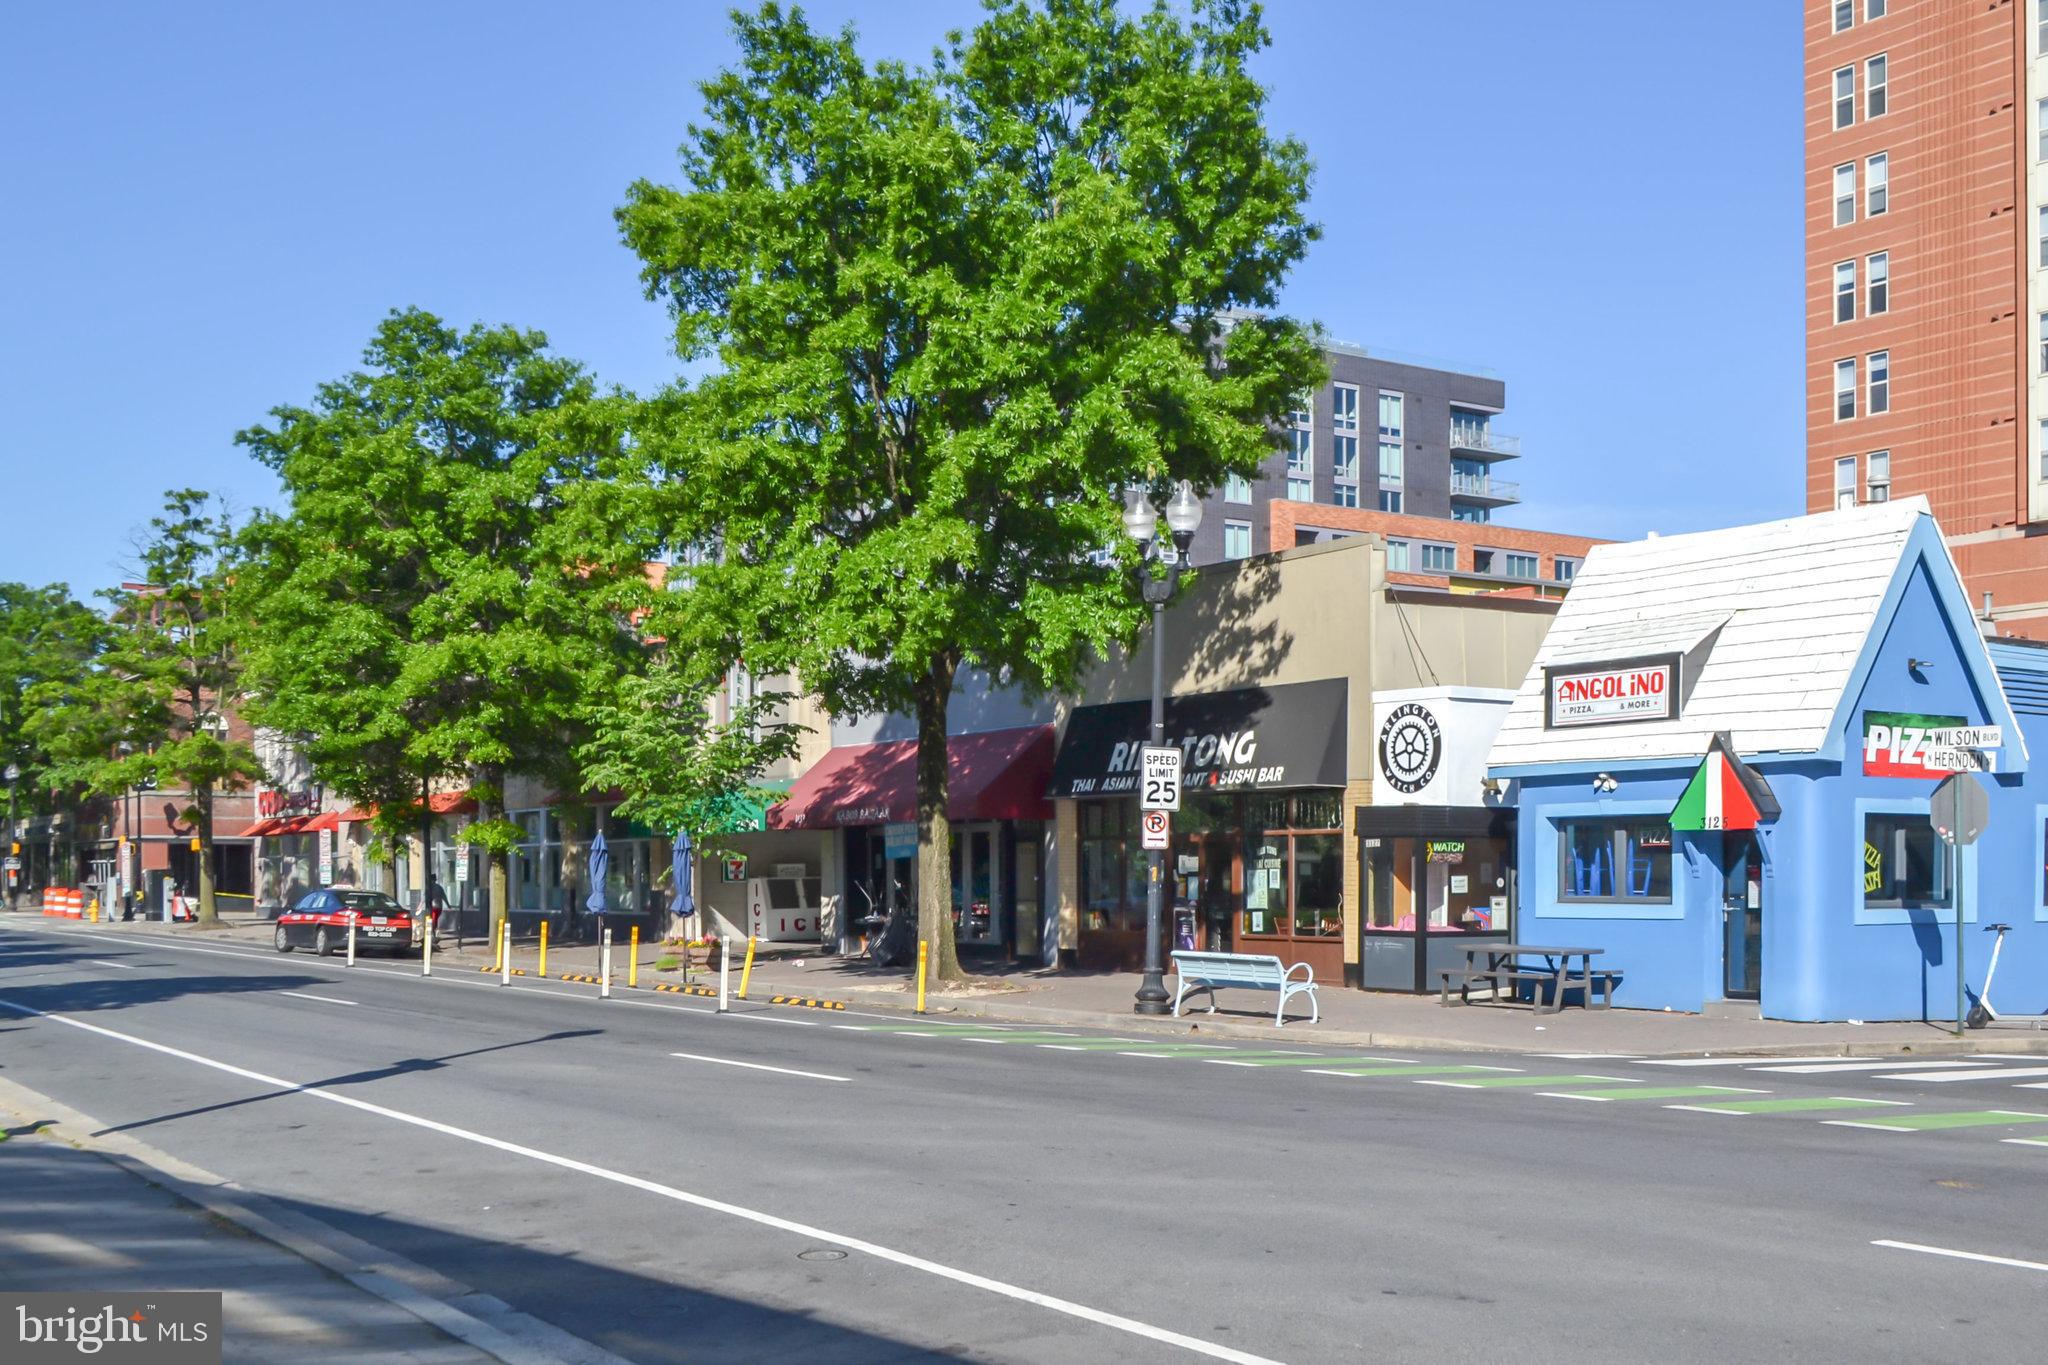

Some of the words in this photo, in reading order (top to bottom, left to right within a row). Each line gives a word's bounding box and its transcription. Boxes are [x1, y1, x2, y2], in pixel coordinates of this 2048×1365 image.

[1627, 700, 1650, 709] MORE
[1381, 704, 1439, 742] ARLINGTON
[1934, 730, 1980, 746] WILSON
[1982, 733, 1999, 741] BLVD
[1180, 730, 1257, 769] TONG
[1146, 755, 1178, 766] SPEED
[1934, 751, 1983, 768] HERNDON
[1149, 768, 1174, 778] LIMIT
[1219, 768, 1257, 785] SUSHI
[1257, 766, 1284, 783] BAR
[1385, 768, 1415, 792] WATCH
[1420, 767, 1436, 786] CO.
[1072, 778, 1096, 792] THAI
[1101, 776, 1135, 791] ASIAN
[1146, 781, 1176, 803] 25
[1700, 816, 1729, 829] 3125
[1433, 842, 1465, 852] WATCH
